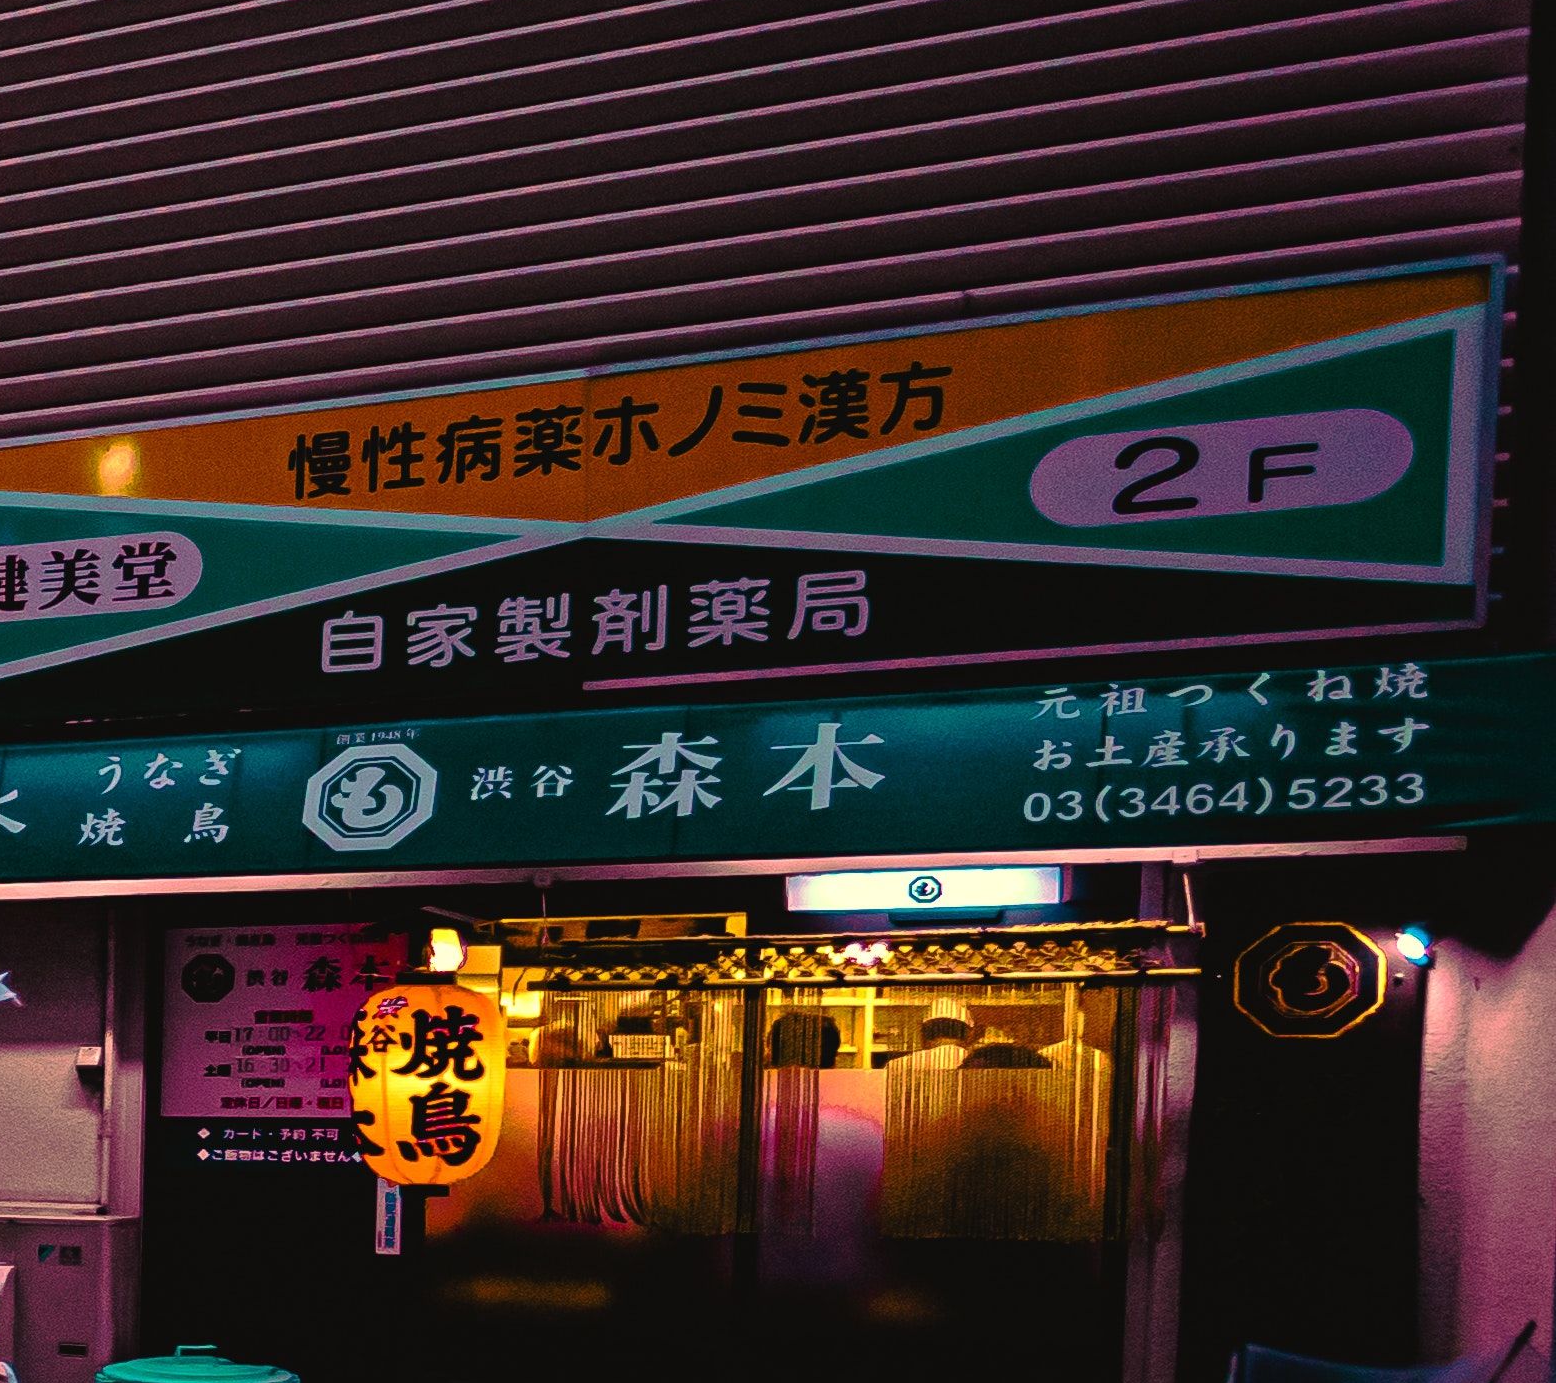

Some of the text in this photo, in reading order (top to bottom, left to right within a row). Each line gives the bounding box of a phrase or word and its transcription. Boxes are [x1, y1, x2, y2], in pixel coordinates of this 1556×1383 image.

[286, 360, 953, 500] 慢性病薬ホノミ漢方
[1112, 435, 1320, 516] 2F
[319, 568, 871, 674] 自家製剤薬局
[1032, 662, 1429, 721] 元祖つくね焼
[96, 747, 242, 794] うなぎ
[605, 721, 886, 820] 森本
[1032, 716, 1431, 772] お土産承ります
[469, 764, 576, 801] 渋谷
[1022, 770, 1427, 823] 03(3464)5233
[78, 800, 230, 848] 焼鳥
[301, 956, 391, 992] 森本
[395, 1007, 485, 1168] 焼鳥
